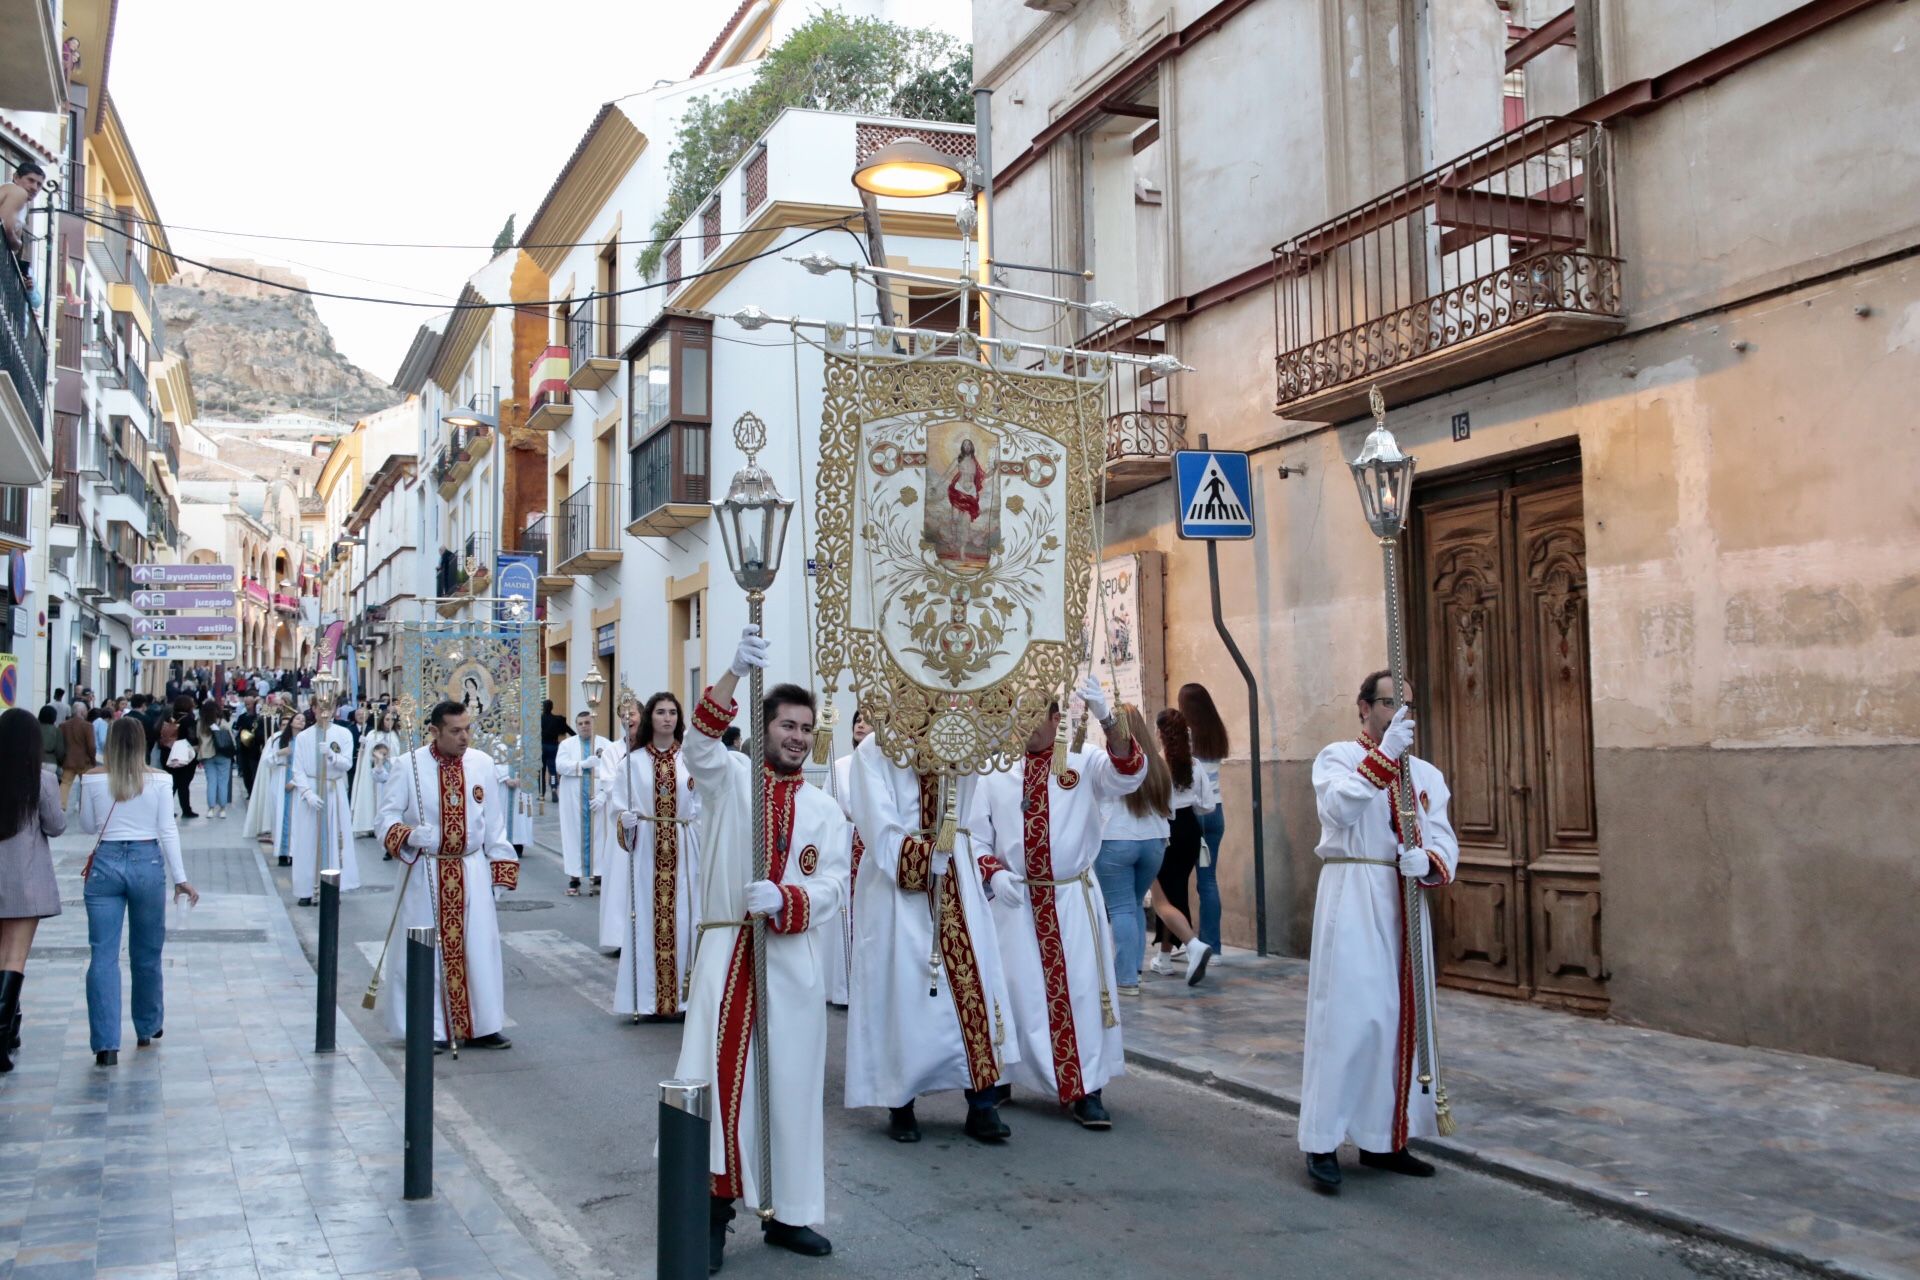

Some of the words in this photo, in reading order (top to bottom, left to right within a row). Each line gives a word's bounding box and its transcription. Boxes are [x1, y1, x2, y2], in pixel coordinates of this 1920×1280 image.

[1455, 416, 1468, 440] 15
[166, 572, 232, 582] ayuntamiento
[194, 598, 233, 608] juzgado
[197, 624, 234, 632] castillo
